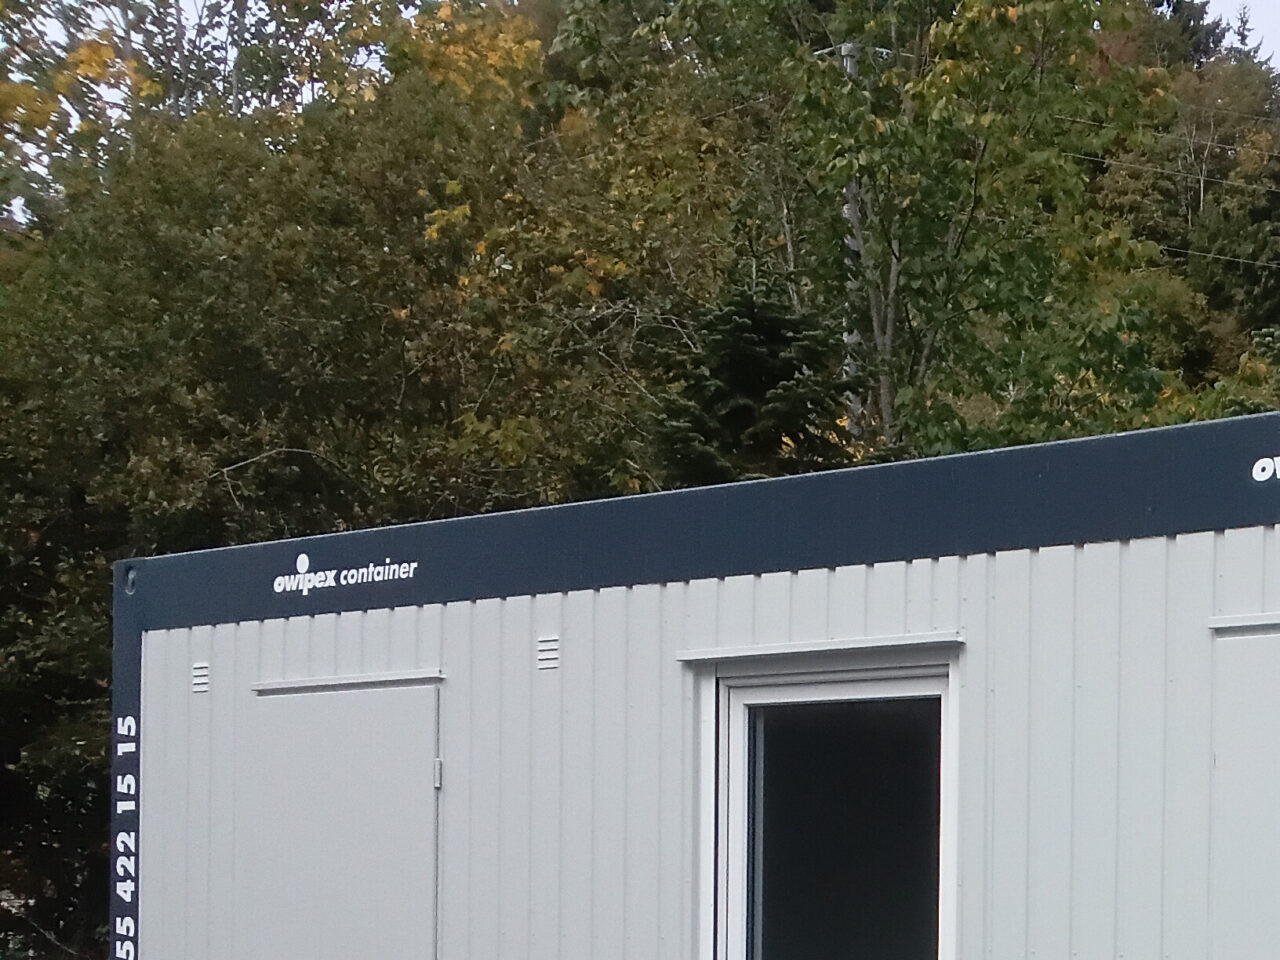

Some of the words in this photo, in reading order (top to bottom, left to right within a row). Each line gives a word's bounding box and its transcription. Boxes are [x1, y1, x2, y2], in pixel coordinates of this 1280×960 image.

[274, 554, 337, 596] owipex
[340, 558, 418, 585] container
[117, 715, 136, 756] 15
[116, 773, 136, 814] 15
[116, 831, 136, 902] 422
